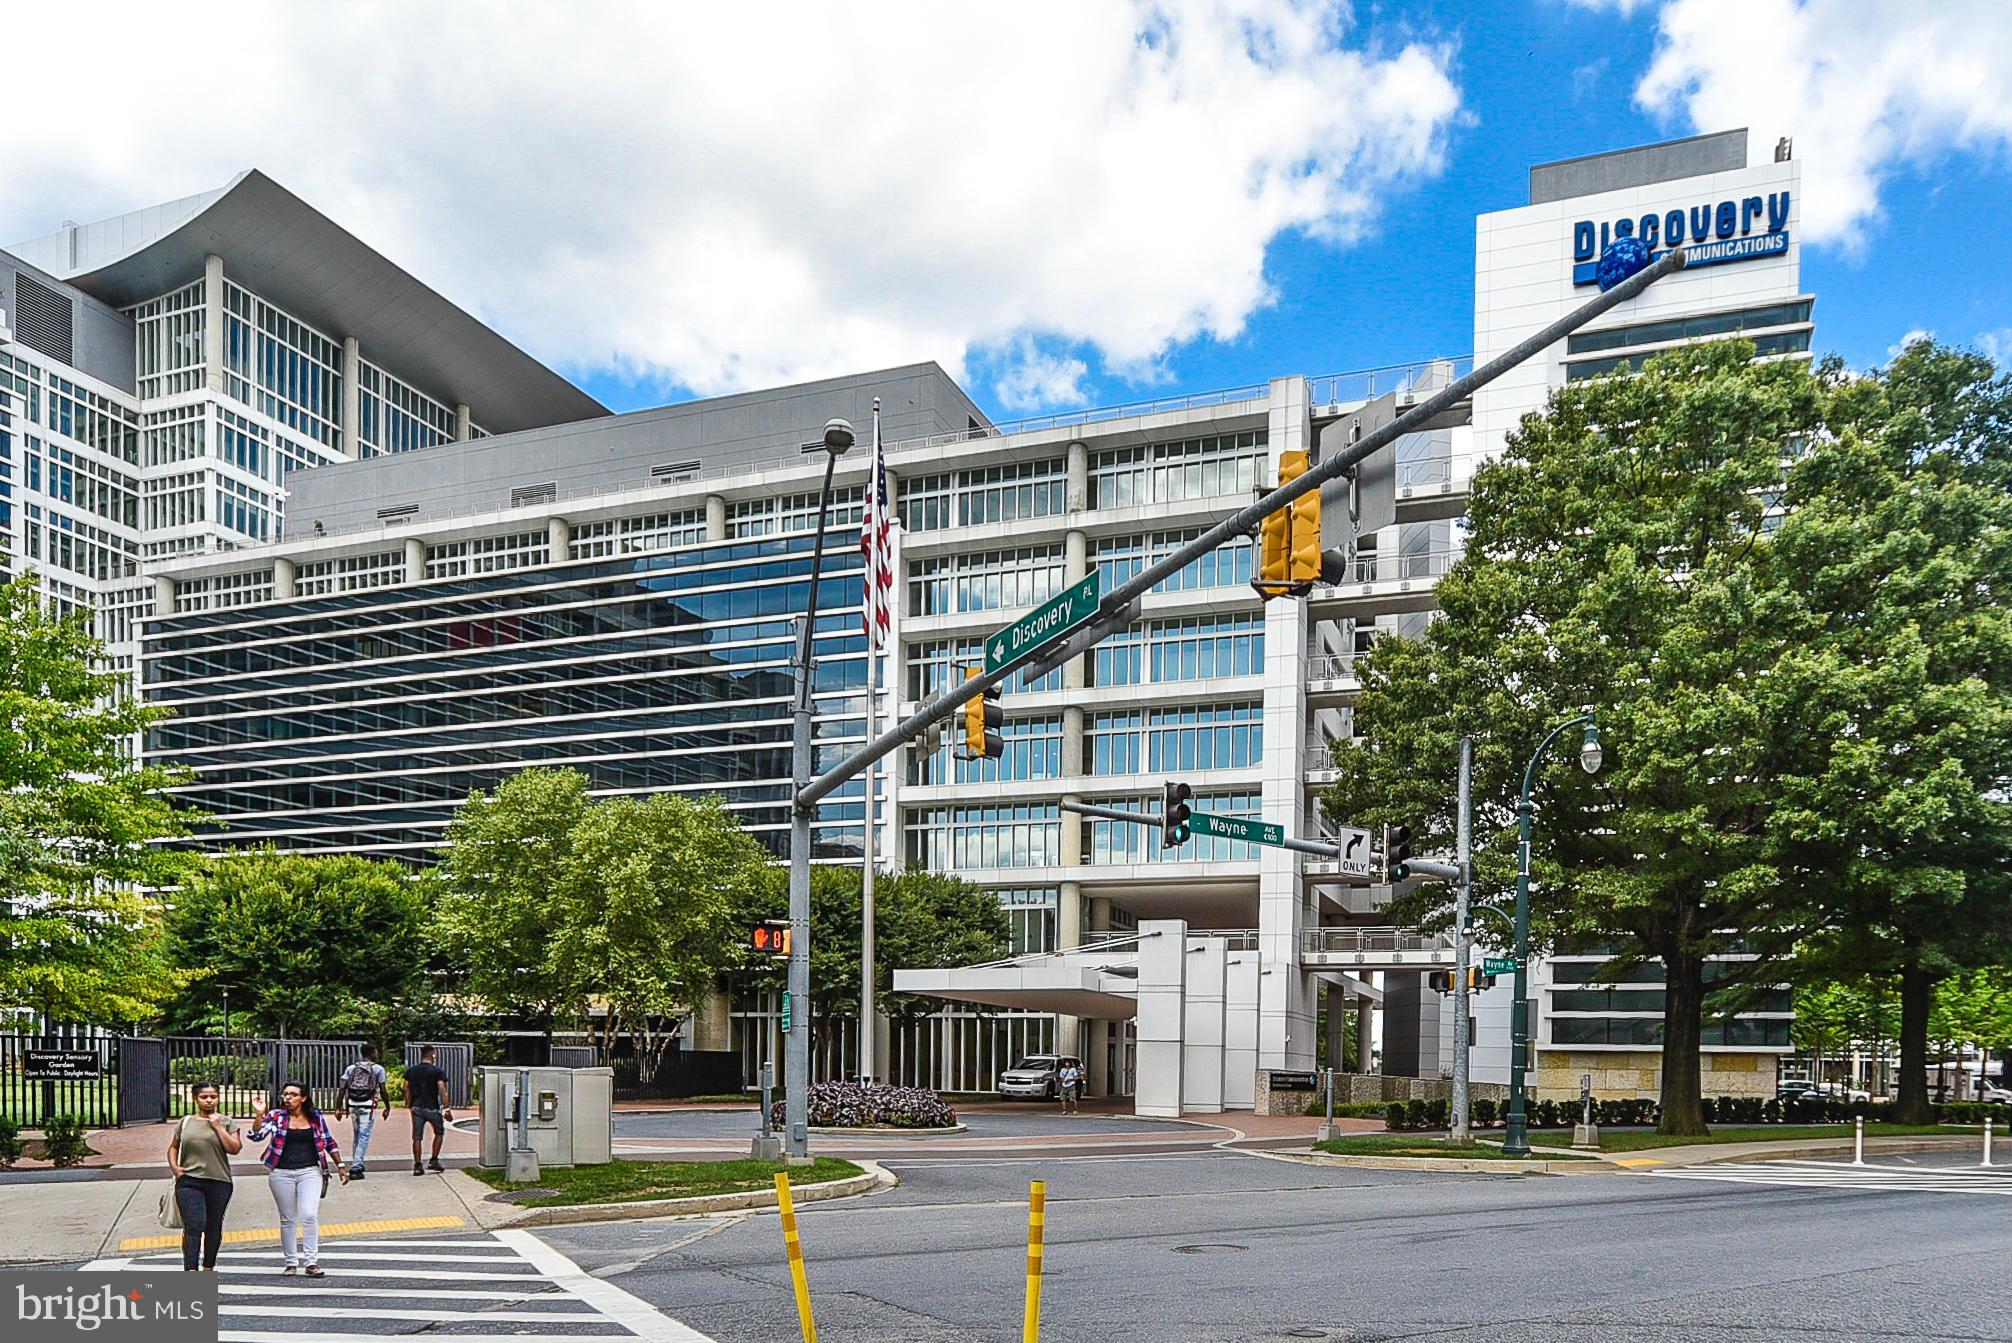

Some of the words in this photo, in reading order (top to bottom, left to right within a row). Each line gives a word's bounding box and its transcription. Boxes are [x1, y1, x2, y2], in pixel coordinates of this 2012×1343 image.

[1574, 191, 1790, 261] Discovery
[1660, 234, 1784, 264] MUNICATIONS
[1012, 598, 1073, 650] Discovery
[1209, 817, 1248, 836] Wayne
[1343, 861, 1366, 874] ONLY
[30, 1053, 64, 1061] Discovery
[65, 1053, 93, 1062] Sensory
[25, 1069, 39, 1077] Open
[63, 1069, 83, 1078] Daylight
